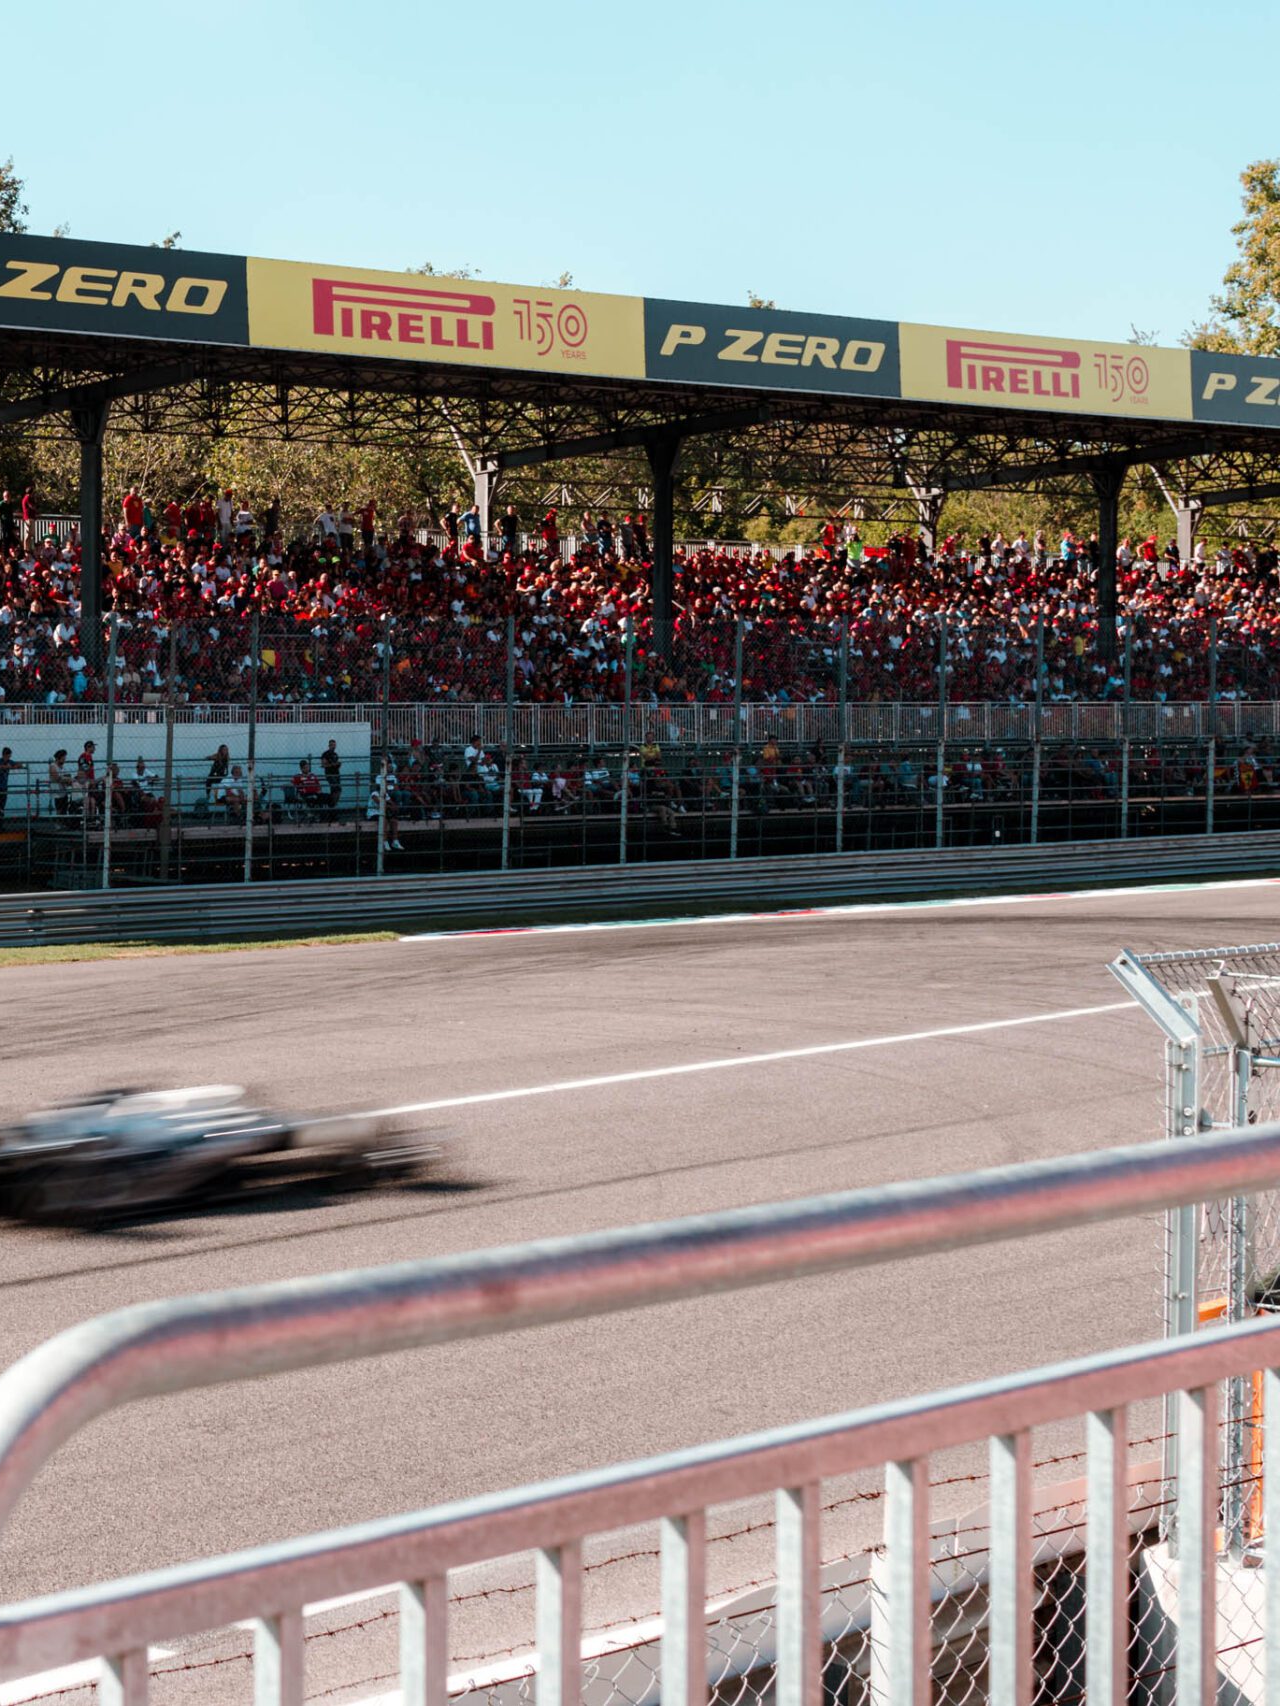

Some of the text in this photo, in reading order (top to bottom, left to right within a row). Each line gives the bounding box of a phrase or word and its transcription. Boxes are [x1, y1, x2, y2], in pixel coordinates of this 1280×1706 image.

[312, 278, 588, 357] PIRELLI 150
[660, 325, 886, 372] P ZERO
[946, 339, 1150, 402] PIRELLI 150
[1202, 372, 1280, 405] P Z
